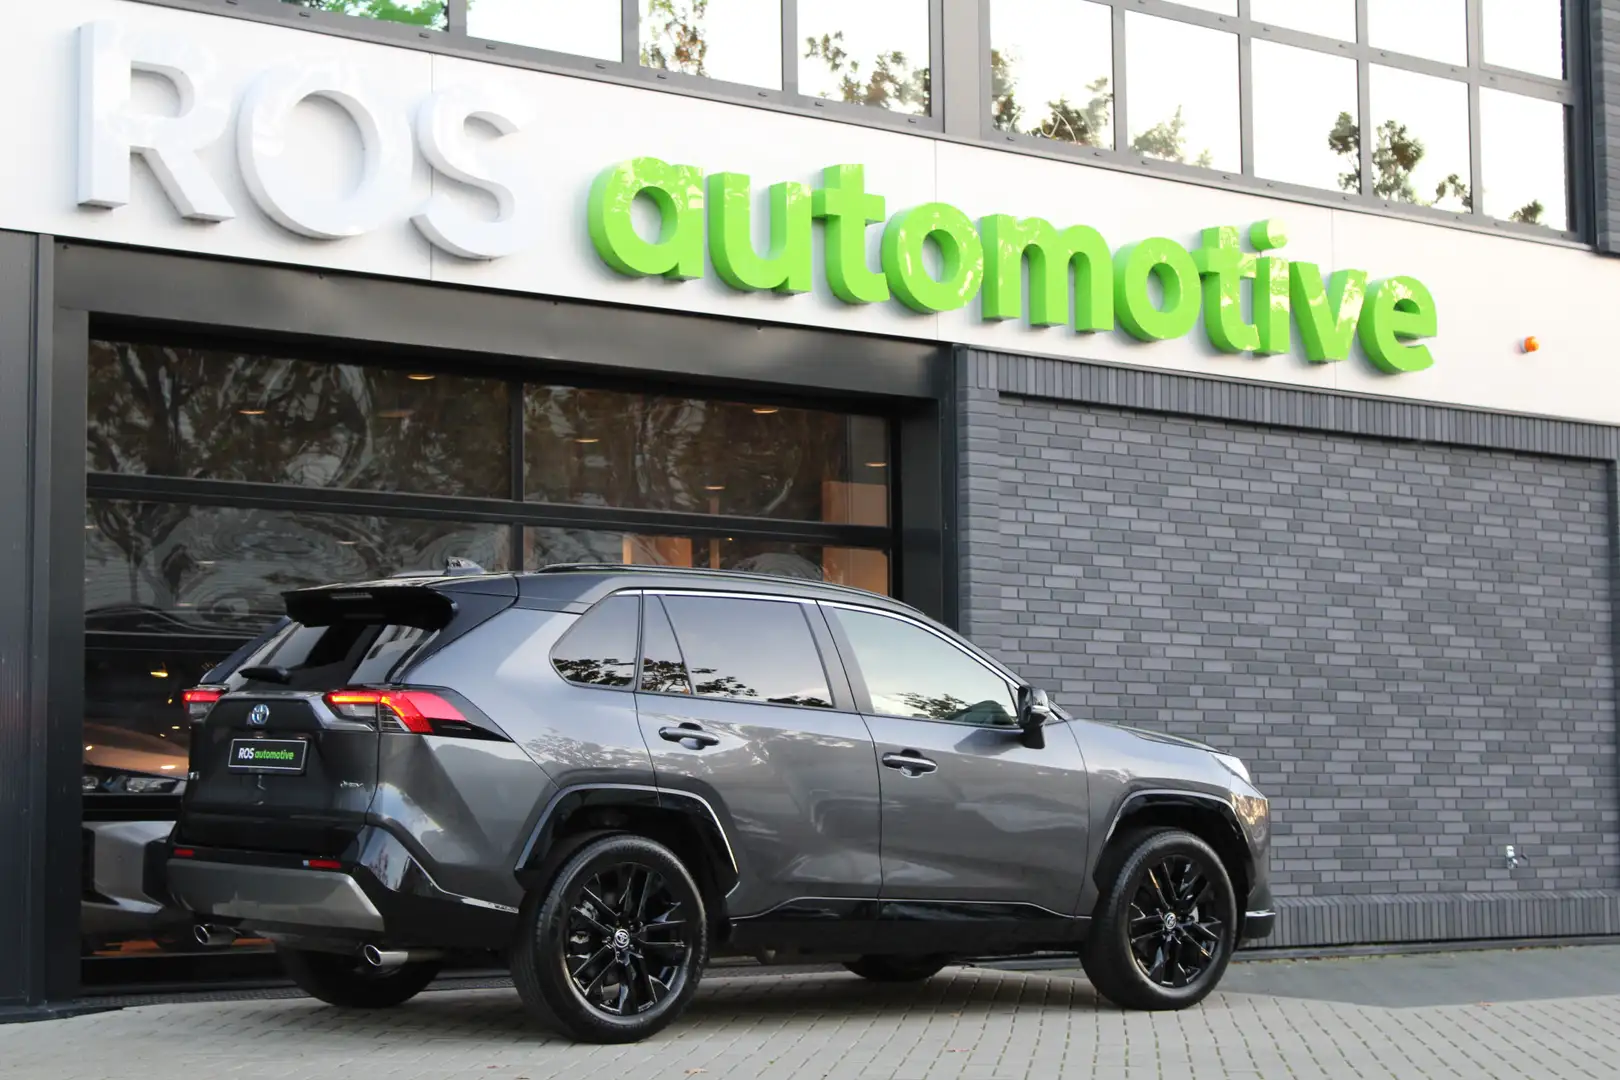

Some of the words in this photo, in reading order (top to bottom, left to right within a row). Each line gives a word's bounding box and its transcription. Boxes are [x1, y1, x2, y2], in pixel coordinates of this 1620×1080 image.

[76, 19, 528, 261] ROS
[588, 157, 1437, 374] automotive
[238, 747, 255, 760] ROS
[254, 749, 295, 760] automotive
